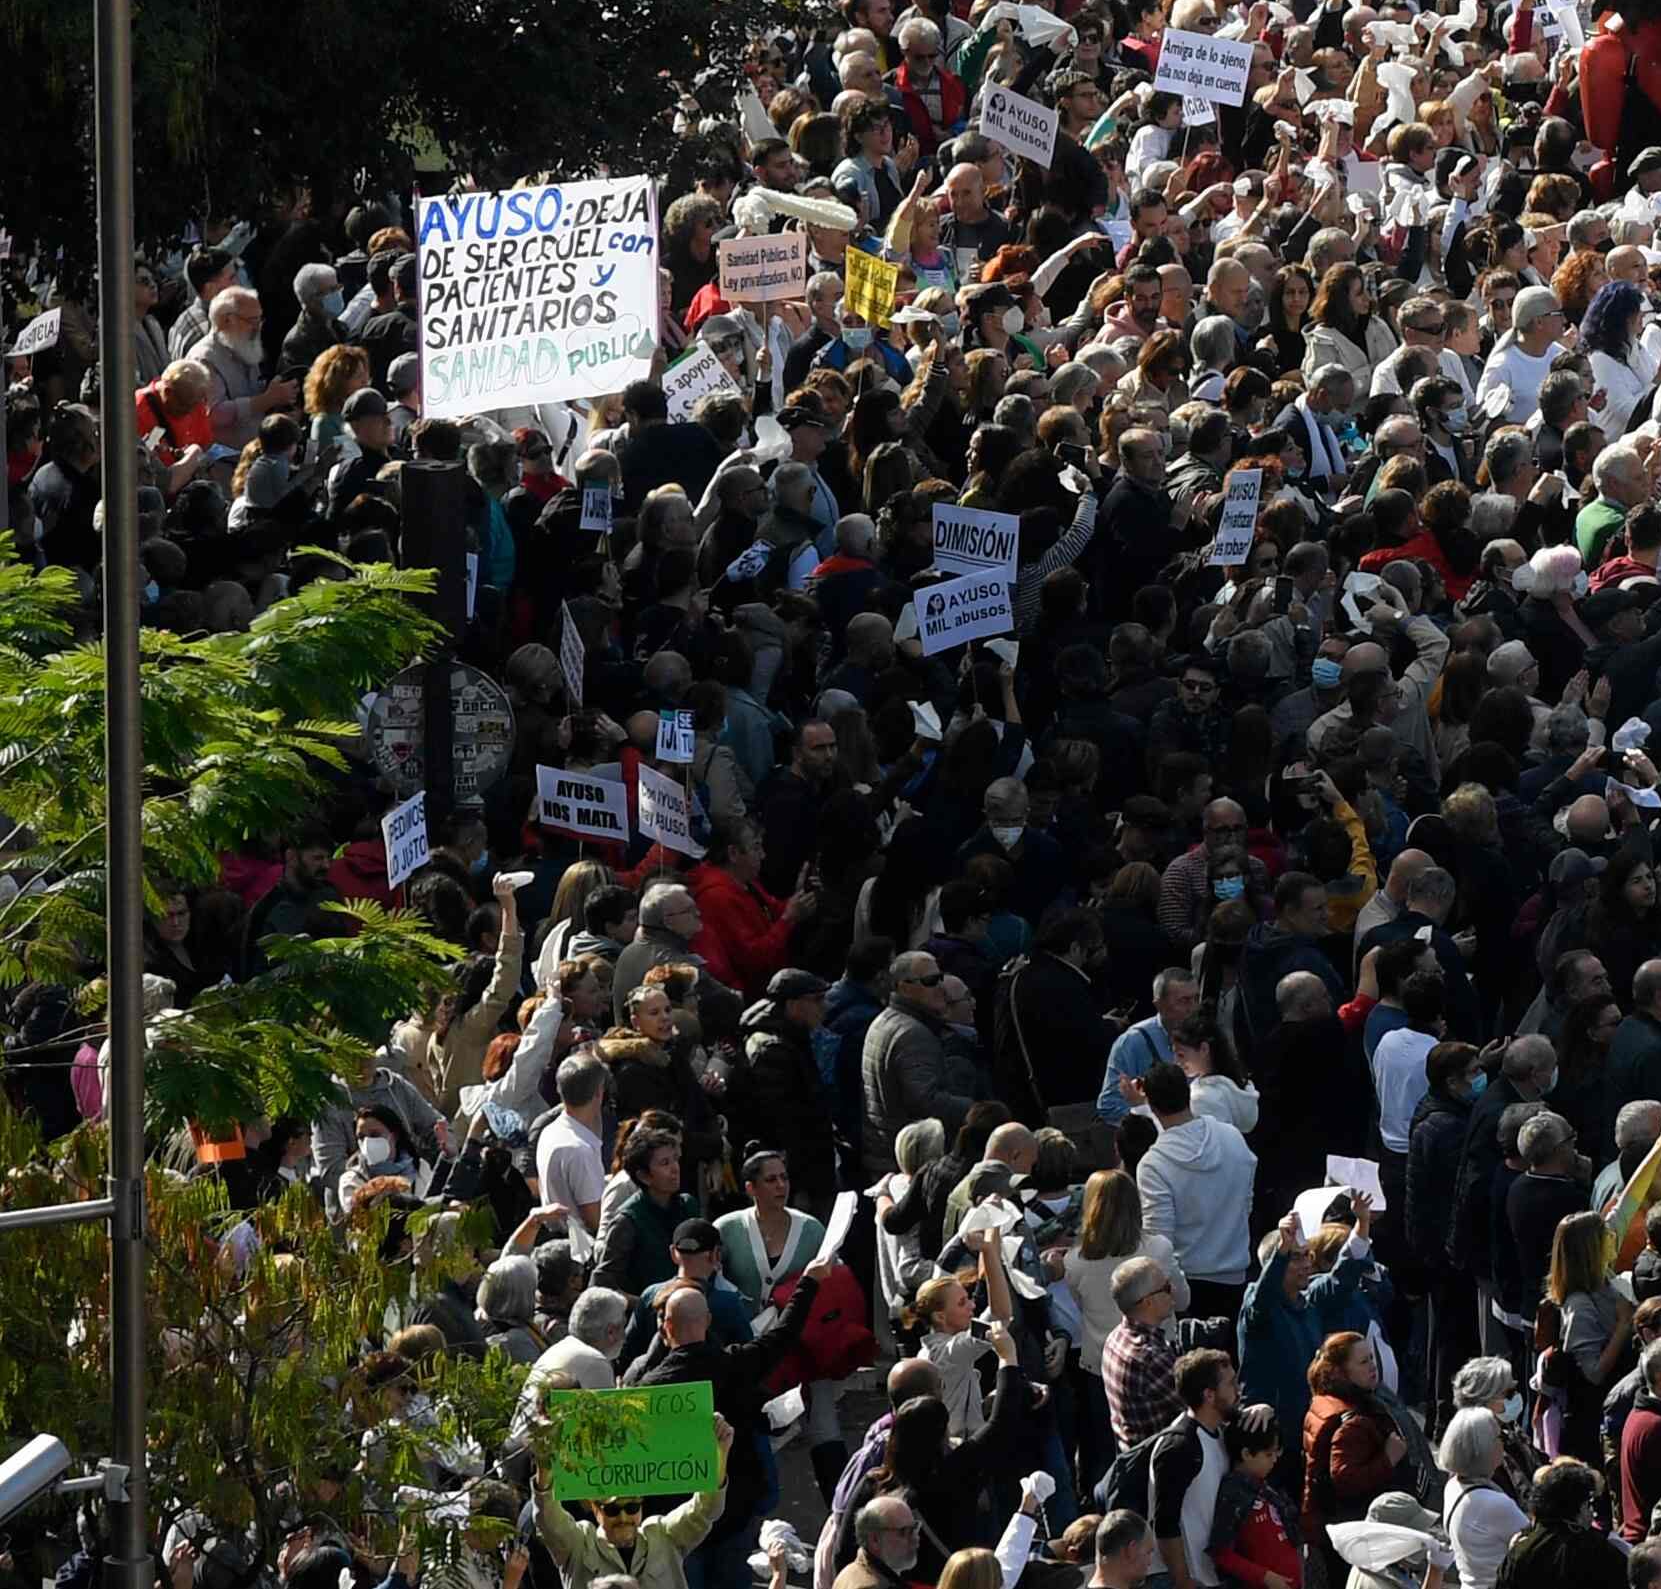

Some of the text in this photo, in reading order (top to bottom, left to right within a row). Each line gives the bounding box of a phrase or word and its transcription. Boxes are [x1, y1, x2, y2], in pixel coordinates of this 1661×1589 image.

[1163, 39, 1247, 71] Amiga de lo ajeno,
[1158, 64, 1171, 78] ella
[1172, 69, 1186, 81] nos
[1188, 67, 1203, 85] deja
[1204, 74, 1214, 86] en
[985, 112, 1049, 152] MIL abusos.
[1008, 105, 1050, 137] AYUSO,
[420, 188, 649, 245] AYUSO: DEJA
[423, 246, 454, 279] DE
[464, 240, 517, 273] SER
[608, 232, 654, 254] con
[727, 249, 759, 267] Sanidad
[424, 262, 615, 314] PACIENTES y
[724, 274, 739, 290] Ley
[426, 291, 617, 348] SANITARIOS
[427, 339, 559, 404] SANIDAD
[675, 354, 716, 390] apoyos
[935, 521, 1015, 562] DIMISIÓN!
[1215, 543, 1224, 557] es
[926, 604, 1011, 637] MIL abusos.
[679, 714, 693, 727] SE
[556, 779, 605, 803] AYUSO
[388, 804, 426, 842] PEDIMOS
[542, 800, 623, 831] NOS MATA.
[586, 1454, 708, 1486] CORRUPCIÓN
